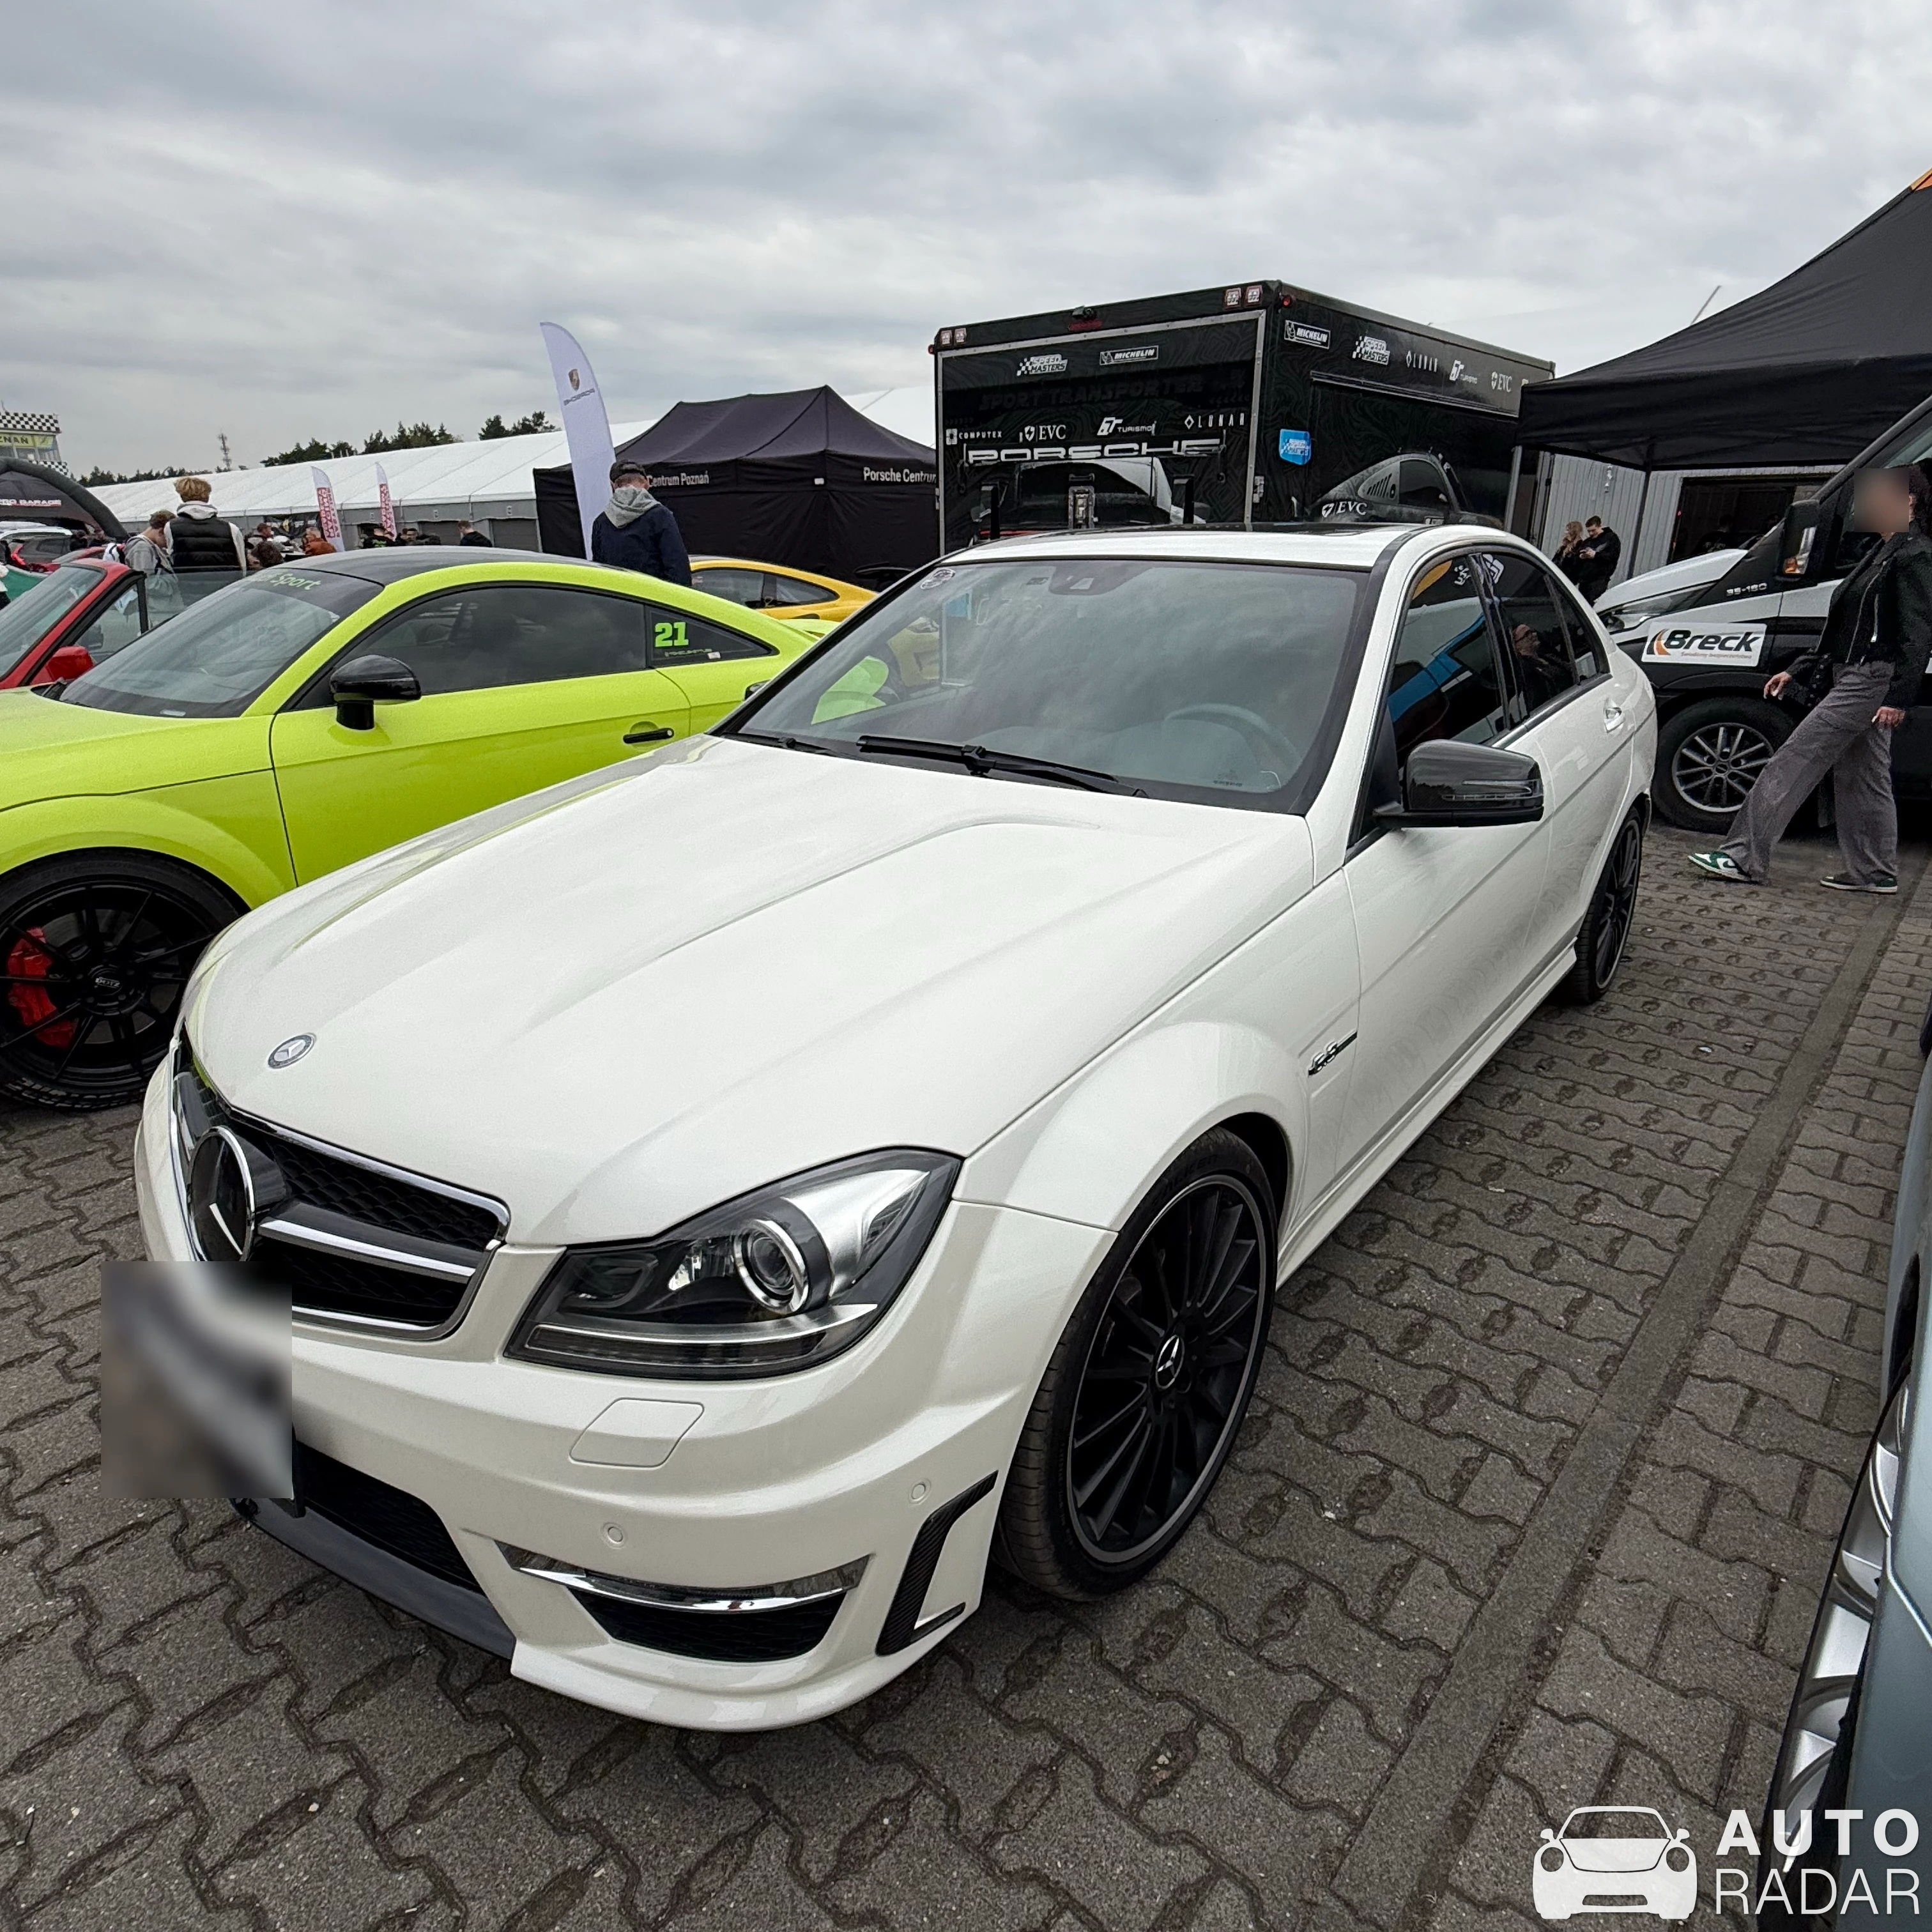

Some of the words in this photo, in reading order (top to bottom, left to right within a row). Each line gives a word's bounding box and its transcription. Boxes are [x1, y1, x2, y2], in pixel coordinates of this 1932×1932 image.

[1296, 328, 1328, 342] MICHELIN
[1031, 356, 1061, 364] SPEED
[1114, 349, 1155, 360] MICHELIN
[1030, 364, 1066, 373] MASTERS
[1198, 413, 1245, 428] LUNAR
[958, 431, 1002, 440] COMPUTEX
[1038, 424, 1066, 440] EVC
[968, 438, 1220, 464] PORSCHE
[647, 475, 680, 487] Centrum
[680, 470, 710, 486] Poznań
[863, 466, 901, 482] Porsche
[1336, 501, 1367, 516] EVC
[270, 572, 321, 590] Sport
[654, 621, 689, 648] 21
[1664, 629, 1761, 652] Breck
